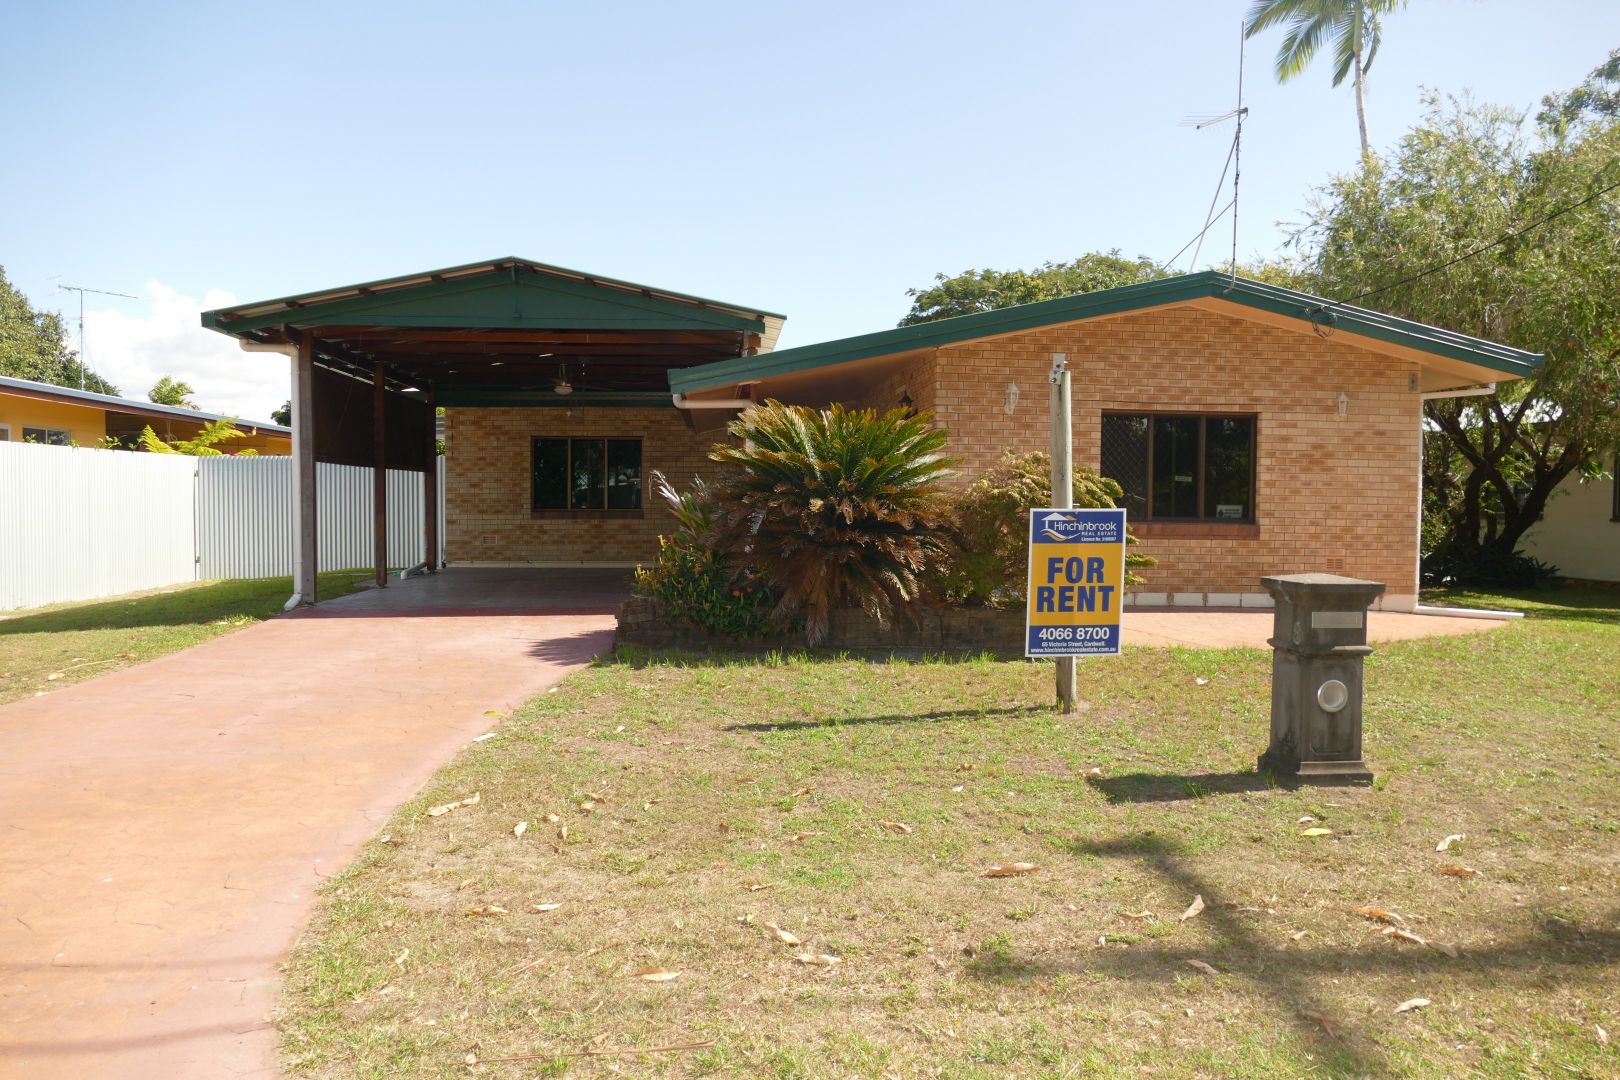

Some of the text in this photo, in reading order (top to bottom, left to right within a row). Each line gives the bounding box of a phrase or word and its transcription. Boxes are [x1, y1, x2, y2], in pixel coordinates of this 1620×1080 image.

[1054, 521, 1117, 531] Hinchinbrook
[1047, 556, 1104, 583] FOR
[1036, 585, 1114, 612] RENT
[1038, 627, 1110, 640] 4066 8700
